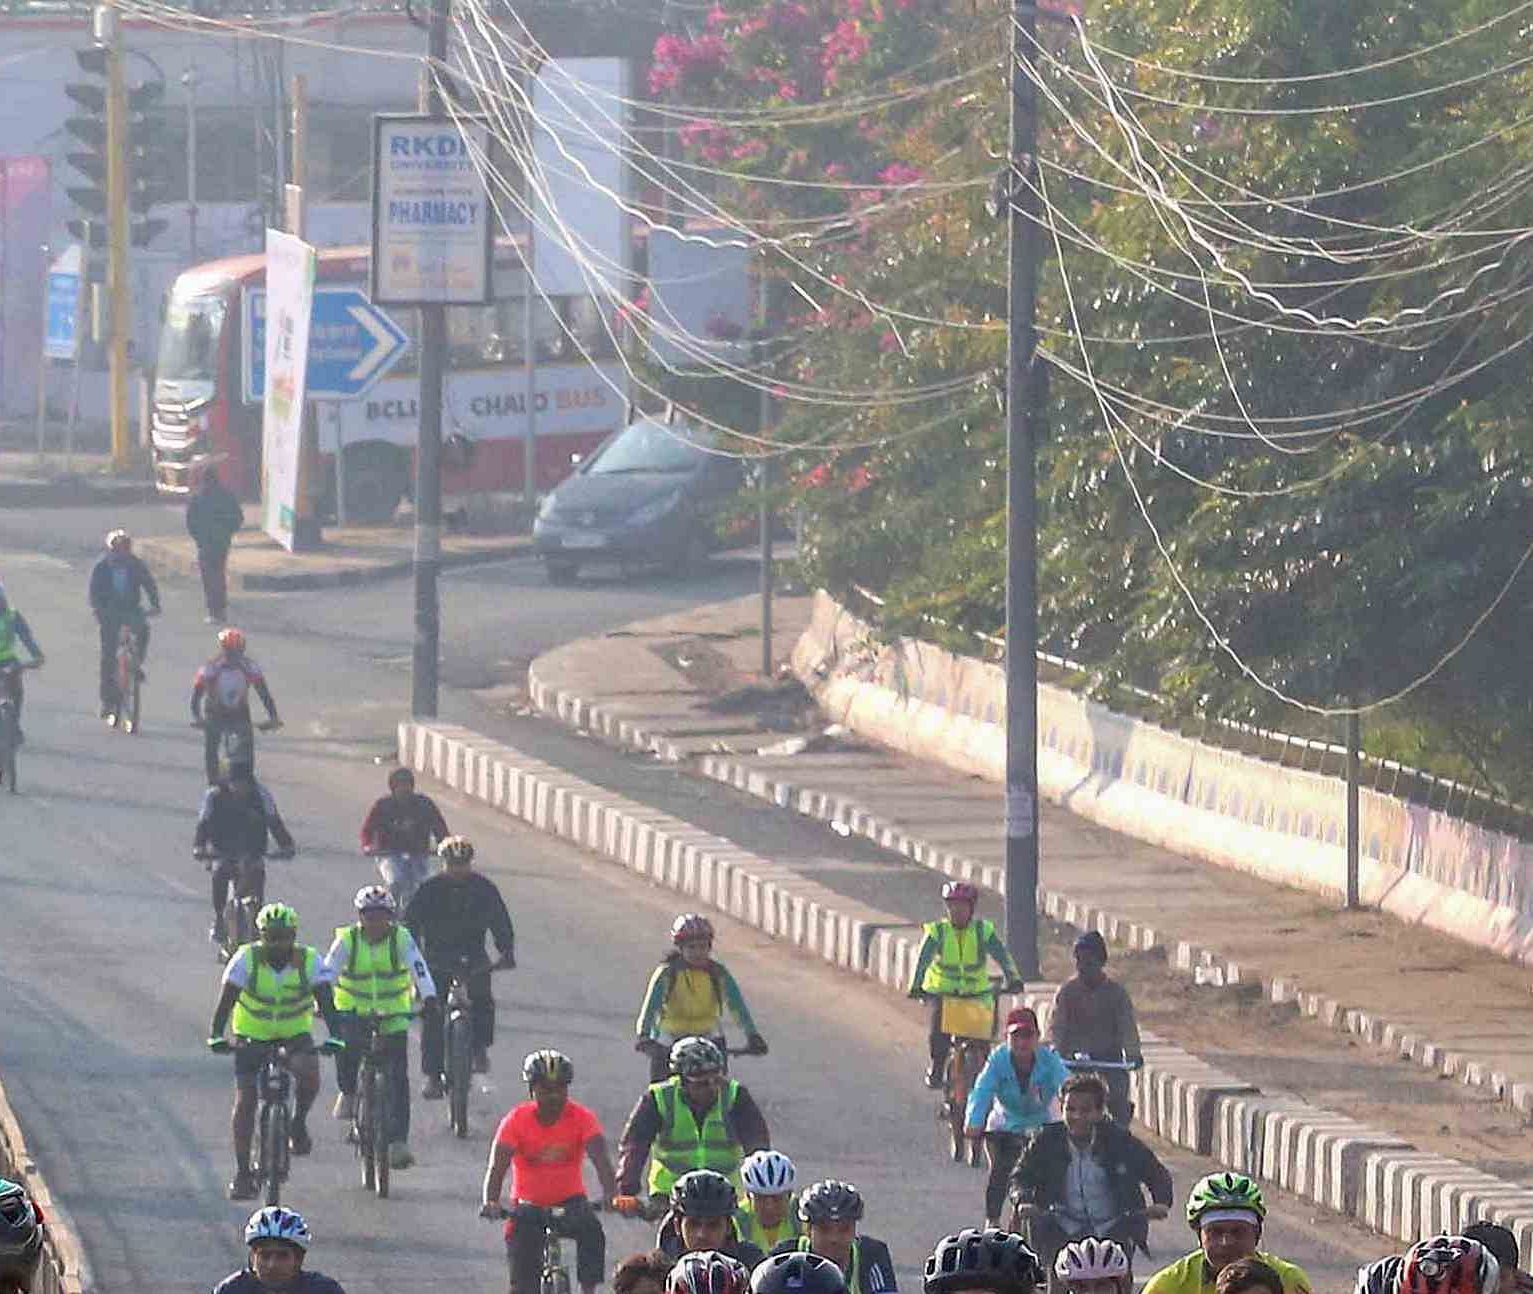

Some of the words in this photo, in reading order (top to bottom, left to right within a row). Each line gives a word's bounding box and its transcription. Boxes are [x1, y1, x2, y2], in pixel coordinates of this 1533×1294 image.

[390, 200, 479, 224] PHARMACY
[469, 392, 548, 416] CHALO
[555, 387, 607, 409] BUS
